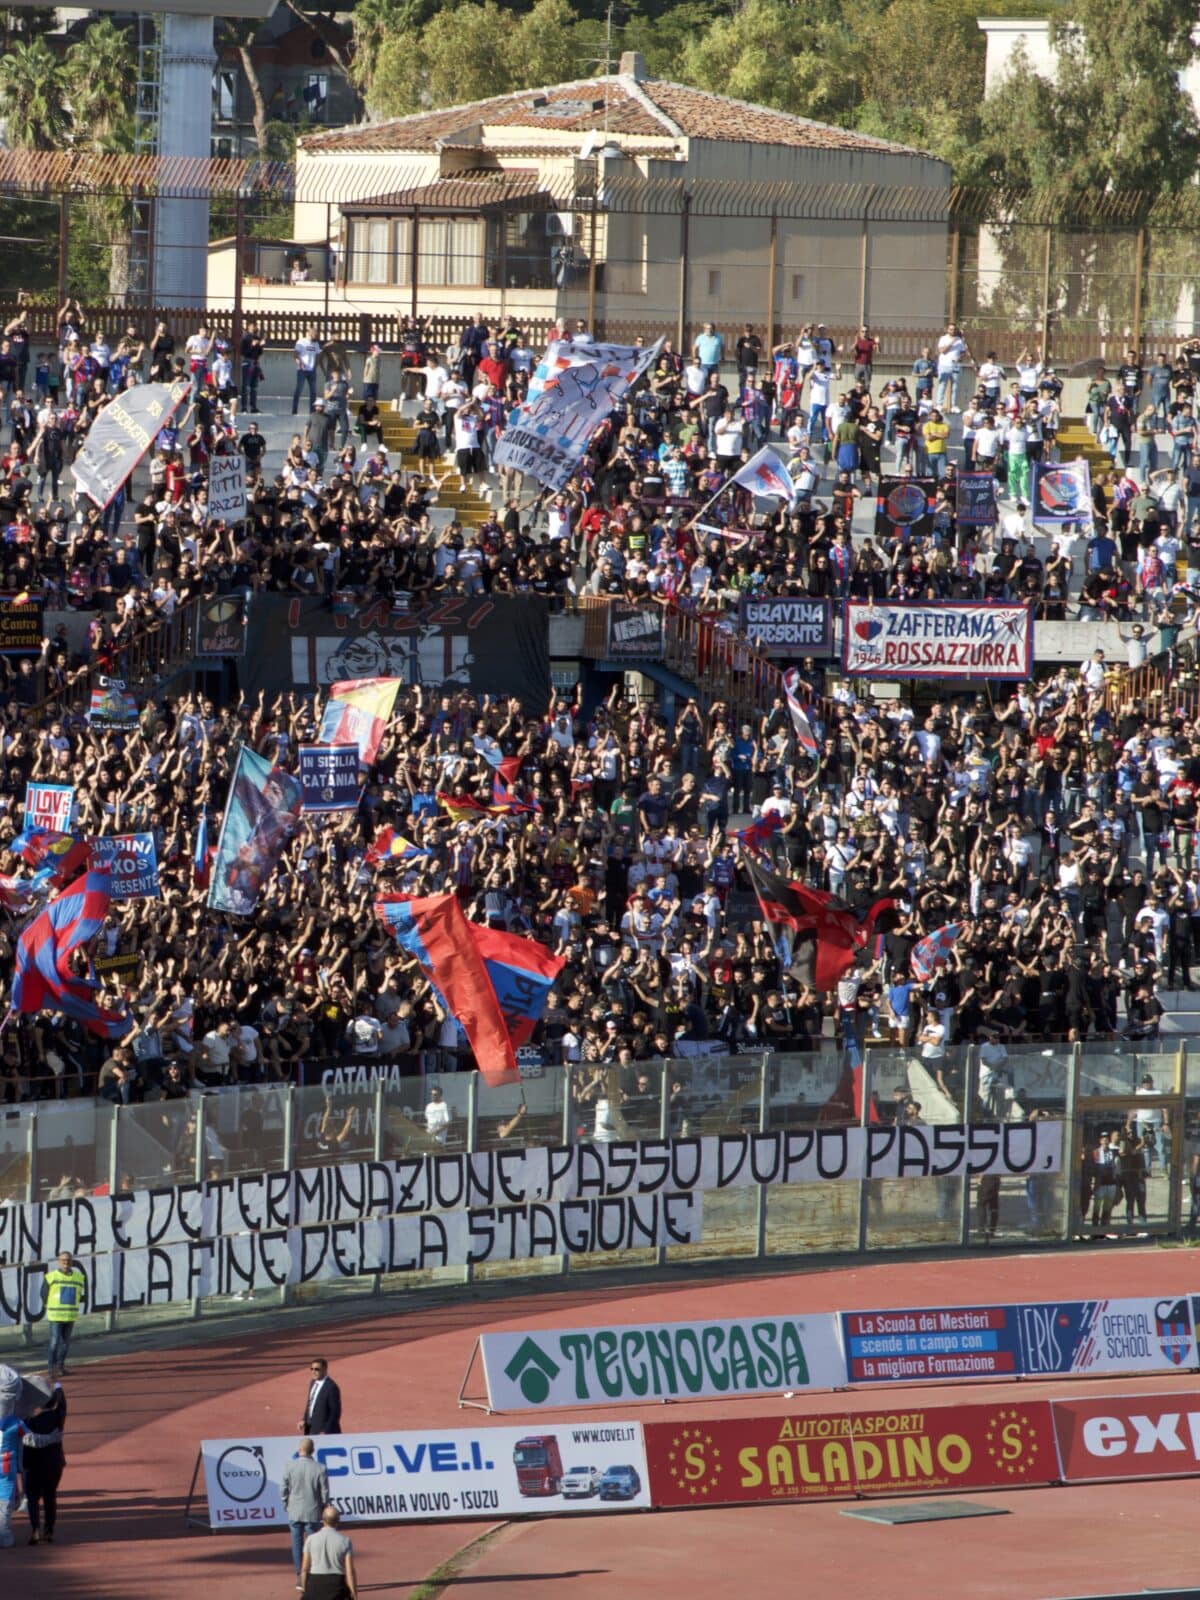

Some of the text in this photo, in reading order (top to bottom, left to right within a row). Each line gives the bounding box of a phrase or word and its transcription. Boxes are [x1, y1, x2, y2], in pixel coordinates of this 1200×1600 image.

[1, 618, 38, 630] Contro
[746, 603, 824, 623] GRAVINA
[747, 624, 823, 643] PRESENTE
[886, 613, 998, 640] ZAFFERANA
[853, 652, 882, 665] 1946
[885, 641, 1020, 666] ROSSAZZURRA
[303, 755, 357, 768] IN SICILIA
[303, 773, 357, 788] CATANIA
[36, 790, 71, 815] LOVE
[321, 1064, 401, 1097] CATANIA
[111, 1192, 136, 1248] E
[548, 1138, 701, 1201] PASSO
[717, 1128, 848, 1188] DOPO
[866, 1123, 1054, 1179] PASSO,
[188, 1230, 288, 1300] FINE
[300, 1214, 449, 1282] DELLA
[466, 1191, 694, 1264] STAGIONE
[859, 1312, 990, 1334] La Scuola dei Mestieri
[1102, 1314, 1153, 1338] OFFICIAL
[861, 1335, 983, 1353] scende in campo con
[1024, 1307, 1063, 1372] ERIS
[1106, 1337, 1153, 1360] SCHOOL
[560, 1321, 811, 1400] TECNOCASA
[863, 1355, 996, 1378] la migliore Formazione
[779, 1414, 925, 1439] AUTOTRASPORTI
[1002, 1423, 1023, 1460] S
[684, 1443, 706, 1480] S
[737, 1433, 972, 1488] SALADINO
[223, 1470, 261, 1479] VOLVO
[217, 1506, 275, 1522] ISUZU
[329, 1496, 410, 1516] ESSIONARIA
[409, 1492, 450, 1512] VOLVO
[461, 1490, 499, 1509] ISUZU
